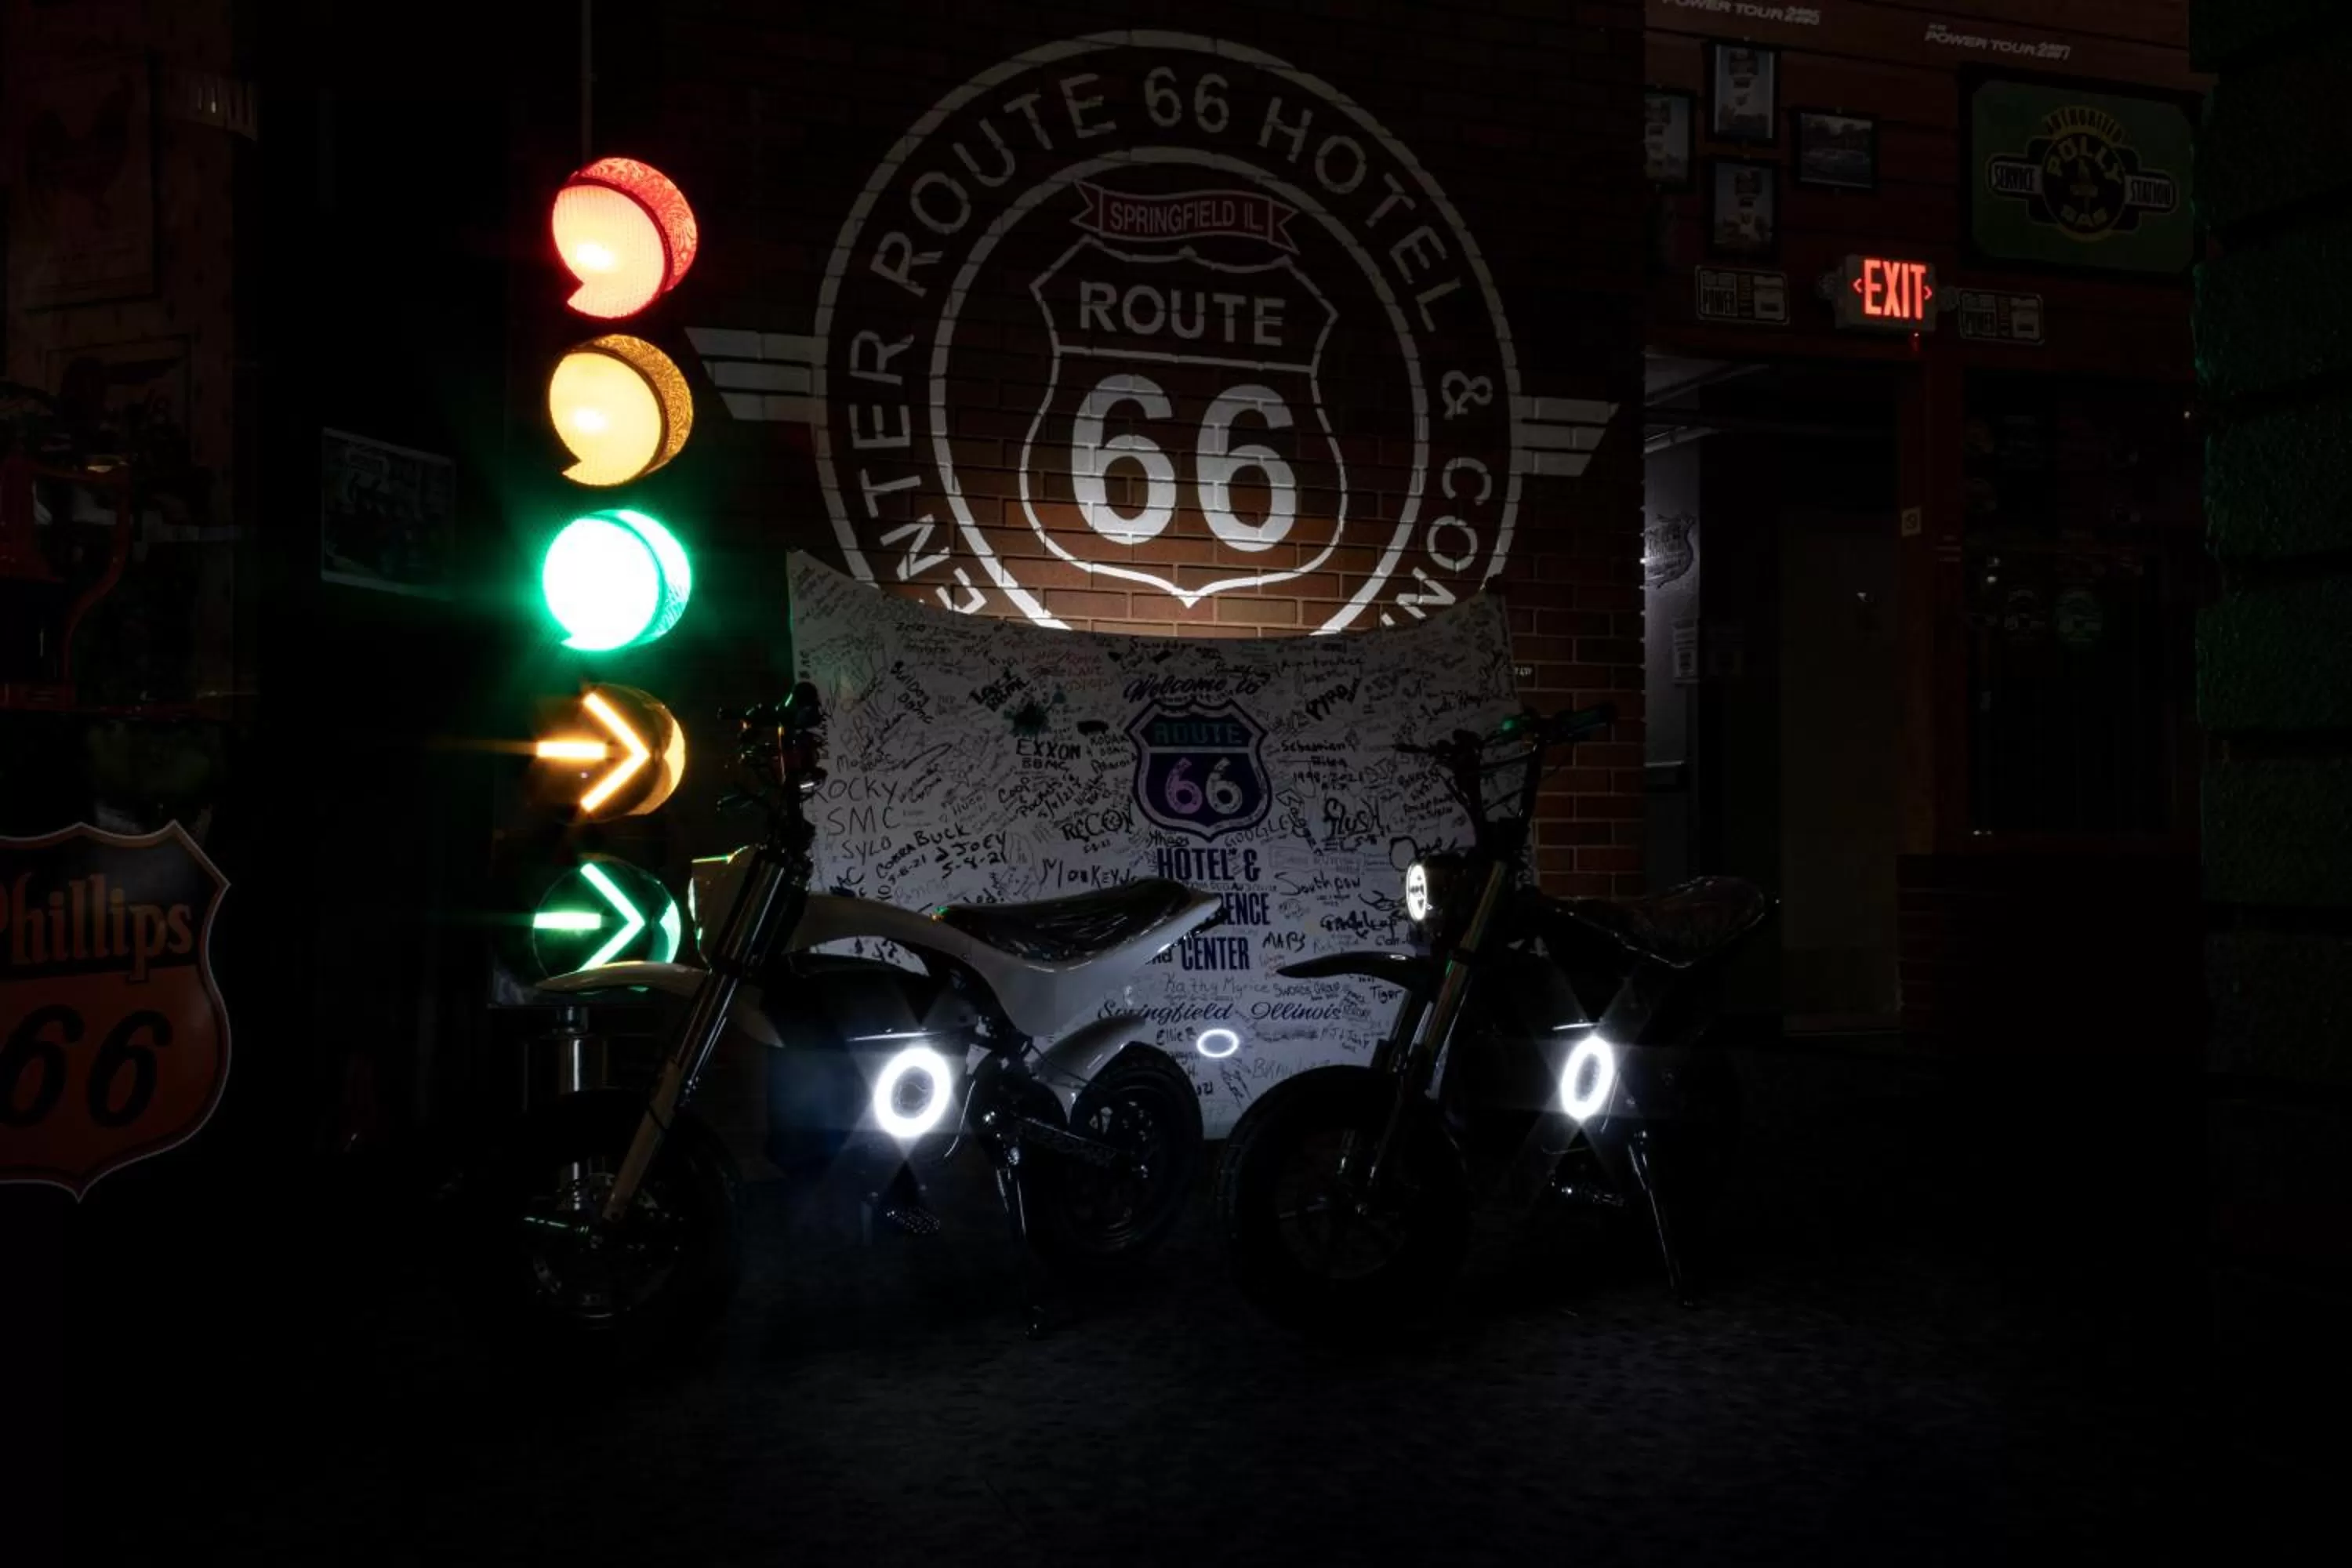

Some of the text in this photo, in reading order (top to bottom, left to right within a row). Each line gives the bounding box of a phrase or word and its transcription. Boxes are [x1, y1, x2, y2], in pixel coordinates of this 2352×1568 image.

[1736, 3, 1783, 21] TOUR
[1925, 31, 1988, 50] POWER
[1991, 39, 2036, 56] TOUR
[1109, 200, 1265, 234] SPRINGFIELD IL
[1864, 260, 1927, 320] EXIT
[1079, 279, 1287, 347] ROUTE
[869, 65, 1494, 626] ROUTE 66 HOTEL & CON
[1071, 372, 1298, 552] 66
[1123, 673, 1228, 703] Welcome
[1236, 675, 1261, 695] to
[1015, 739, 1081, 760] EXXON
[1153, 720, 1243, 745] ROUTE
[813, 775, 901, 806] ROCKY
[1164, 756, 1244, 815] 66
[826, 804, 901, 836] SMC
[913, 822, 971, 847] BUCK
[951, 829, 1007, 857] JOEY
[1156, 848, 1261, 882] HOTEL &
[0, 870, 195, 984] hillips
[1181, 937, 1250, 971] CENTER
[0, 1004, 173, 1128] 66
